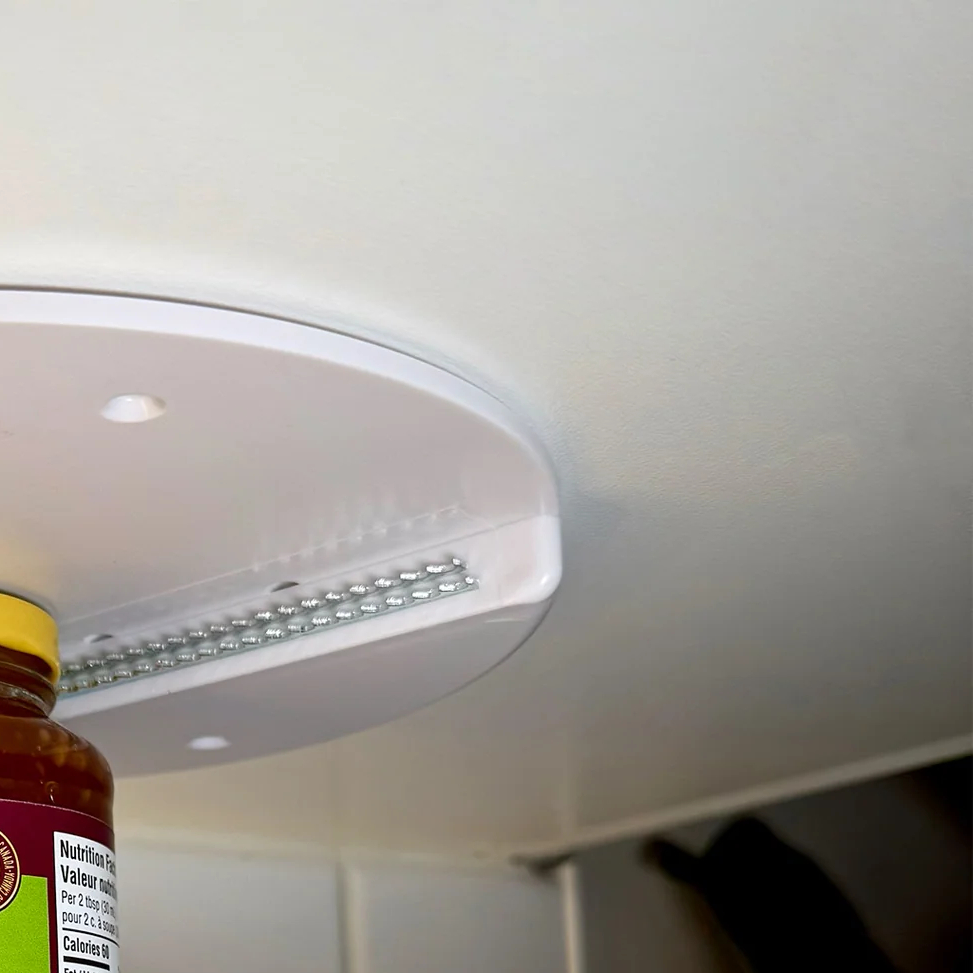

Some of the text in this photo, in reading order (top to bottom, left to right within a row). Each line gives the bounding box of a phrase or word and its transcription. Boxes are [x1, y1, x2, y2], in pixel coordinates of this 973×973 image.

[59, 839, 105, 869] Nutrition
[60, 864, 98, 890] Valeur
[61, 890, 77, 905] Per
[78, 893, 84, 907] 2
[85, 895, 100, 912] tbsp
[62, 911, 82, 925] pour
[83, 912, 89, 925] 2
[90, 916, 97, 928] c.
[98, 916, 102, 930] à
[63, 935, 110, 960] Calories 60
